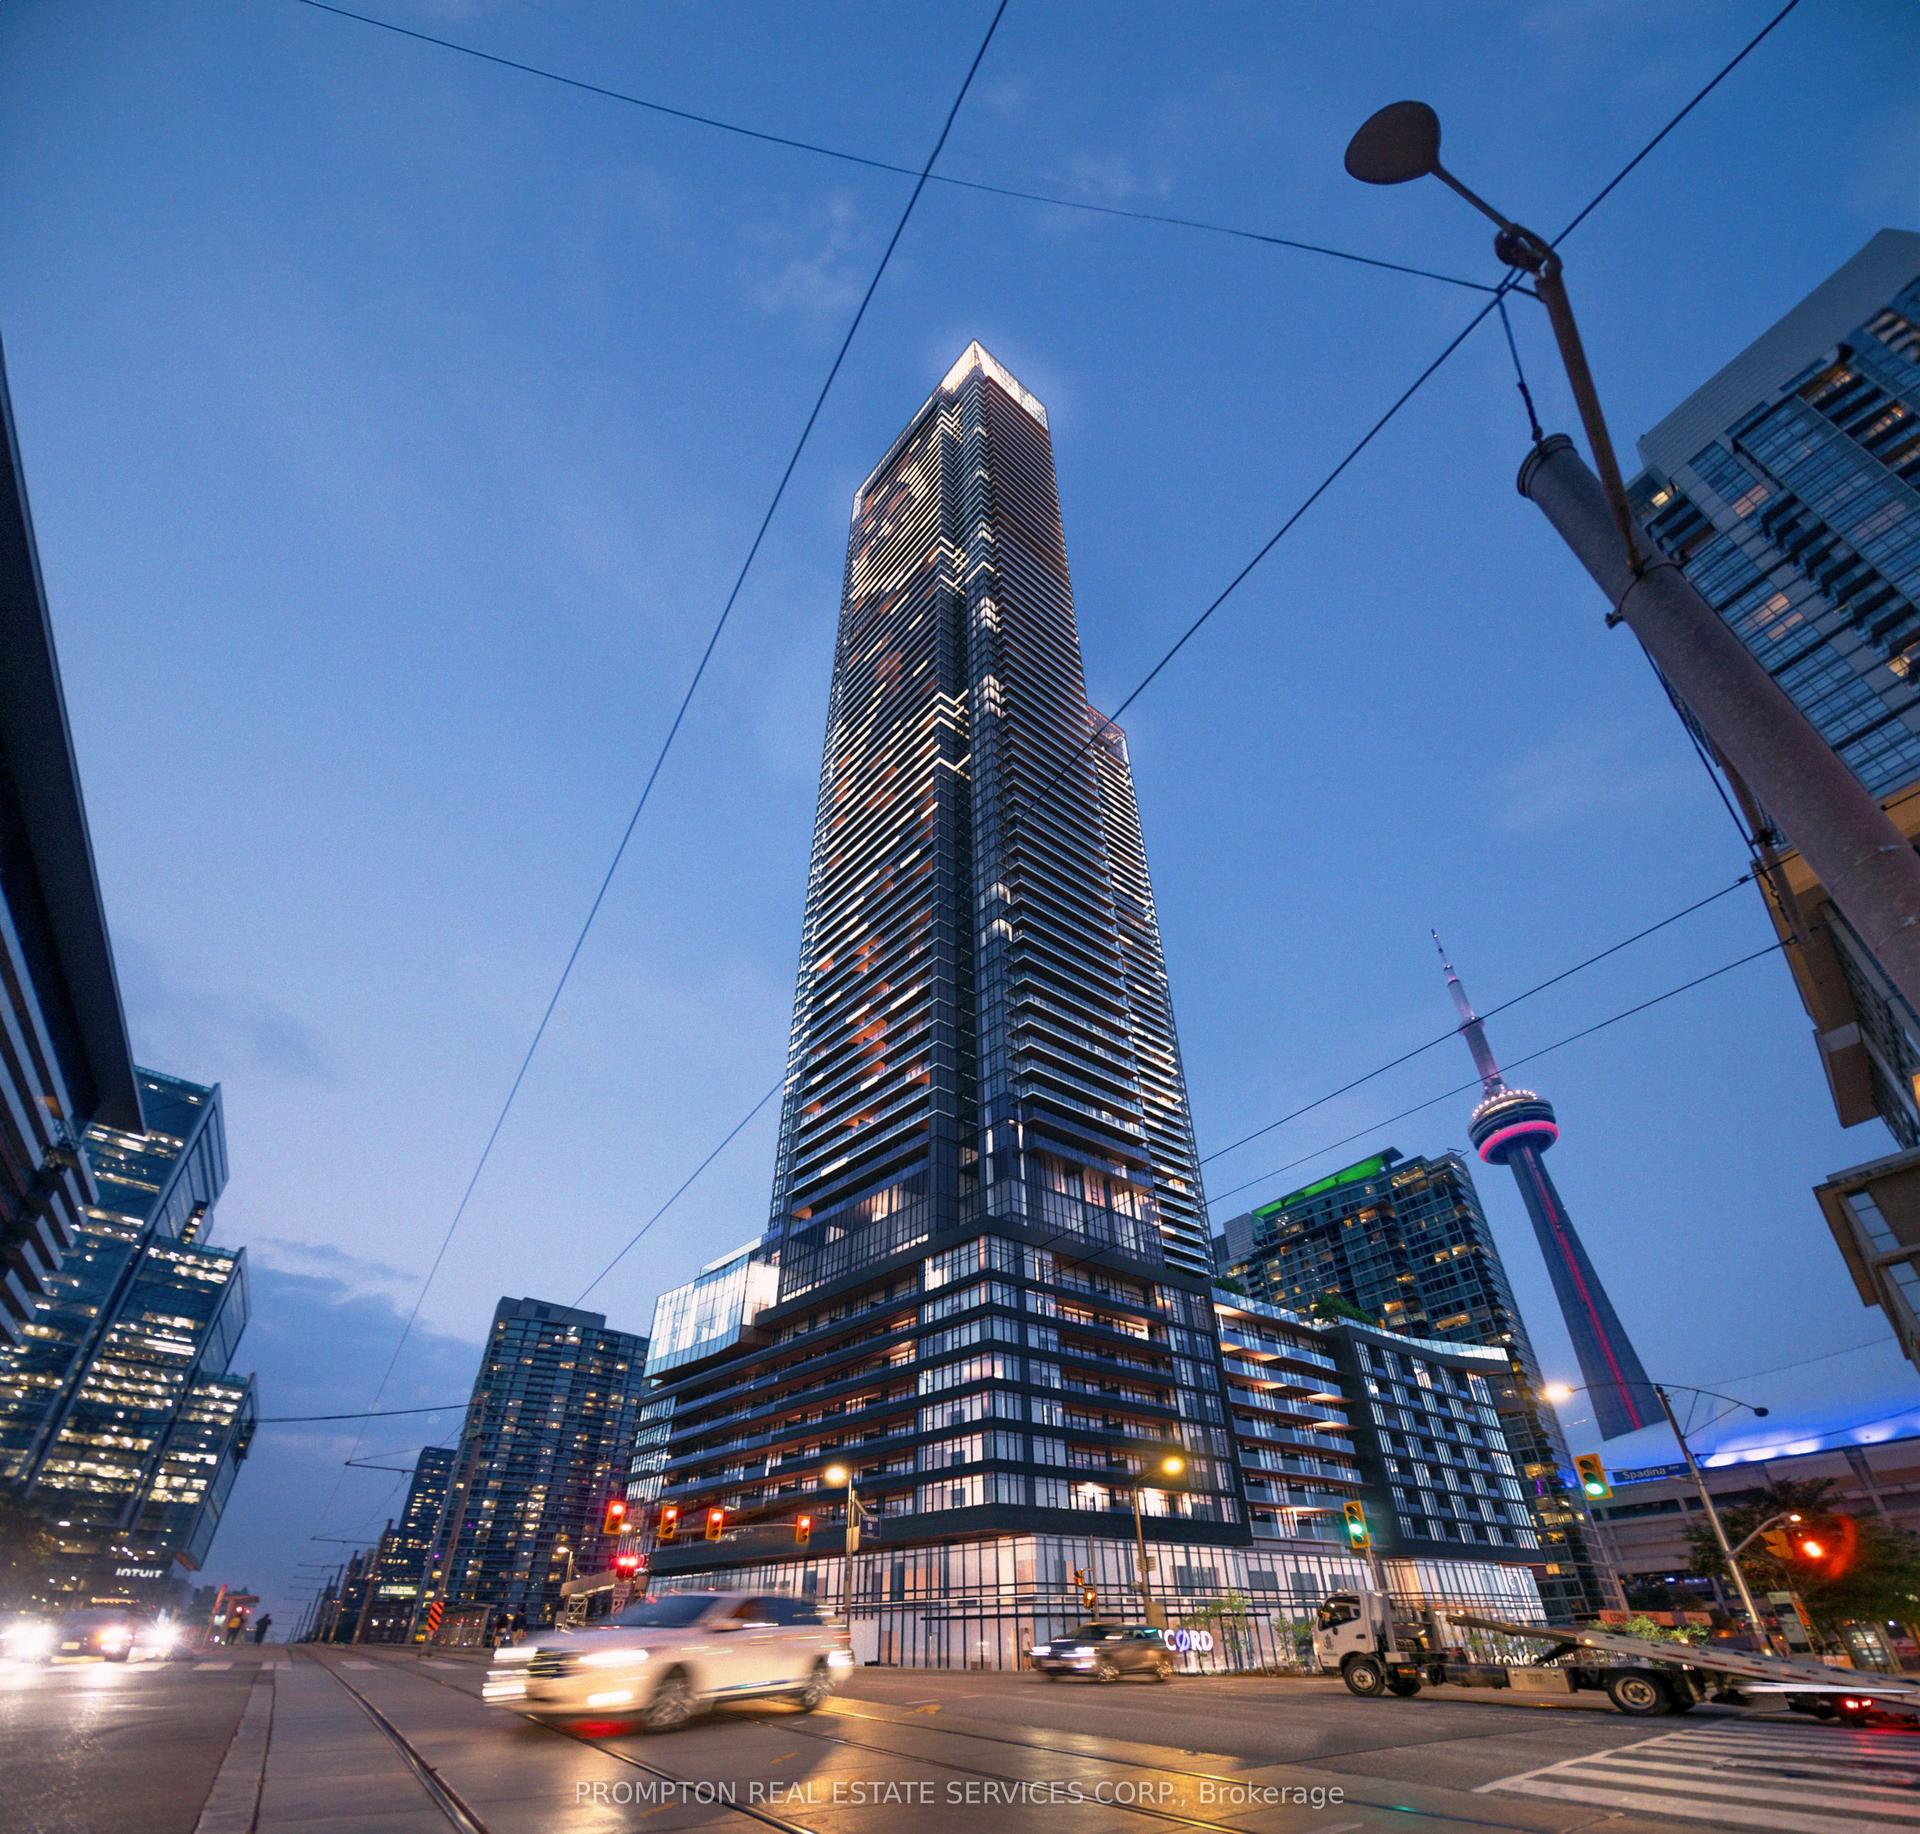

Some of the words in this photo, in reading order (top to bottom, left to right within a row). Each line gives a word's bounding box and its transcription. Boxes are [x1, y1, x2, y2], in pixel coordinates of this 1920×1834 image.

[1622, 1467, 1667, 1480] Spadina
[115, 1567, 163, 1578] INTUIT
[1157, 1629, 1213, 1652] CORD
